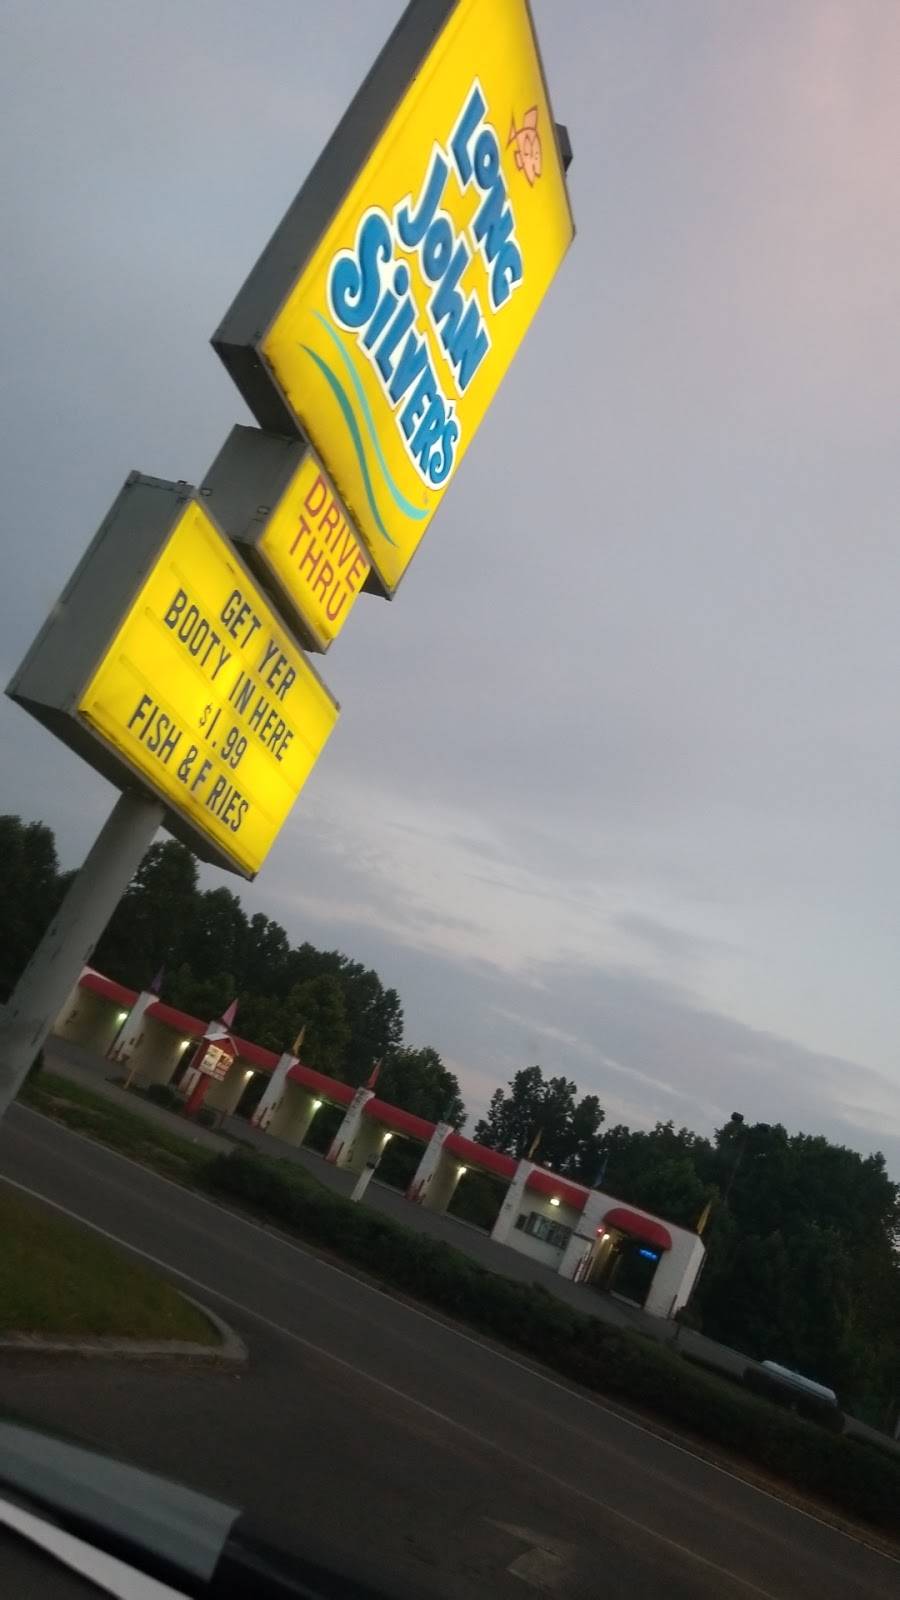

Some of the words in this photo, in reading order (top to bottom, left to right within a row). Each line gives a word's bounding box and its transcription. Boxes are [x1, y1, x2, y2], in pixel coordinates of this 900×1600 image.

[290, 515, 353, 621] THRU
[304, 477, 371, 592] DRIVE
[164, 589, 231, 680] BOOTY
[229, 671, 256, 715] IN
[249, 697, 294, 762] HERE
[220, 590, 262, 648] GET
[257, 640, 296, 701] YER
[127, 694, 181, 764] FISH
[198, 703, 248, 770] $1.99
